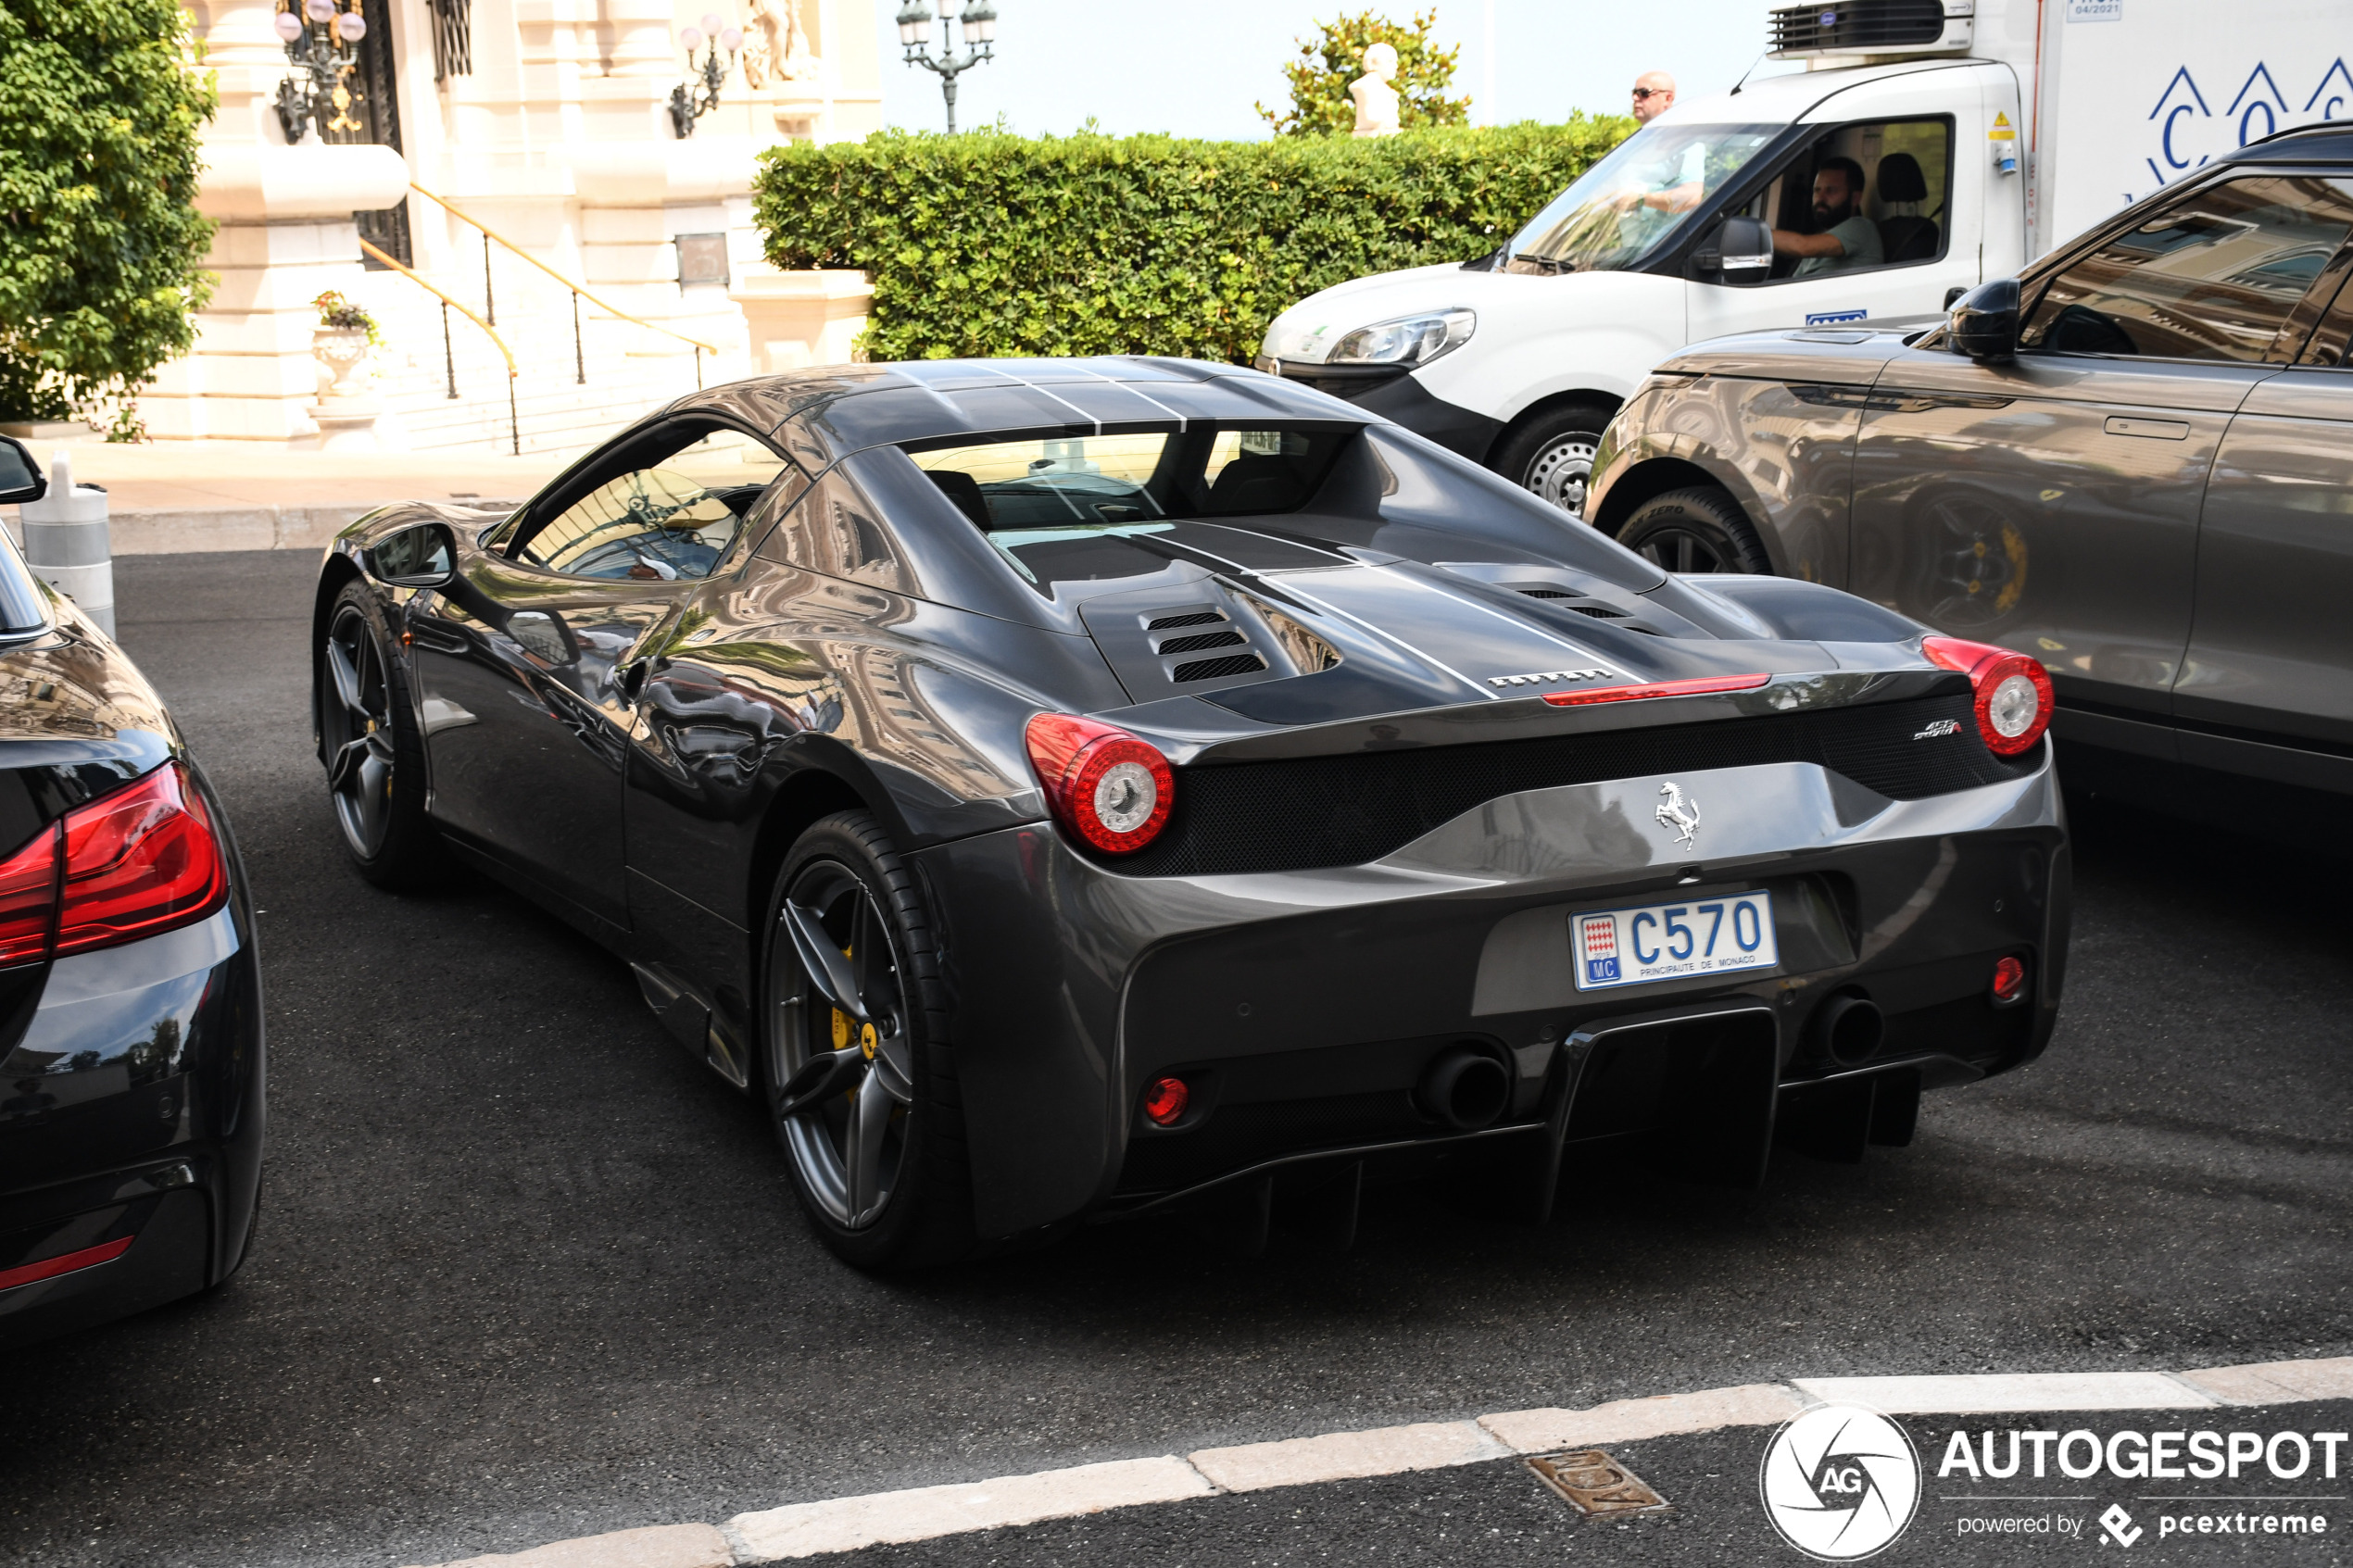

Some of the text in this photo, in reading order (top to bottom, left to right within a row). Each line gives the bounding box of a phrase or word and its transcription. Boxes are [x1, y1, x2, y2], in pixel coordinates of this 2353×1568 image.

[2075, 4, 2119, 15] 04/2021
[1648, 505, 1685, 520] ZERO
[1631, 899, 1762, 965] C570
[1592, 960, 1615, 978] MC
[1640, 955, 1756, 977] PRINCIPAUTE DE MONACO
